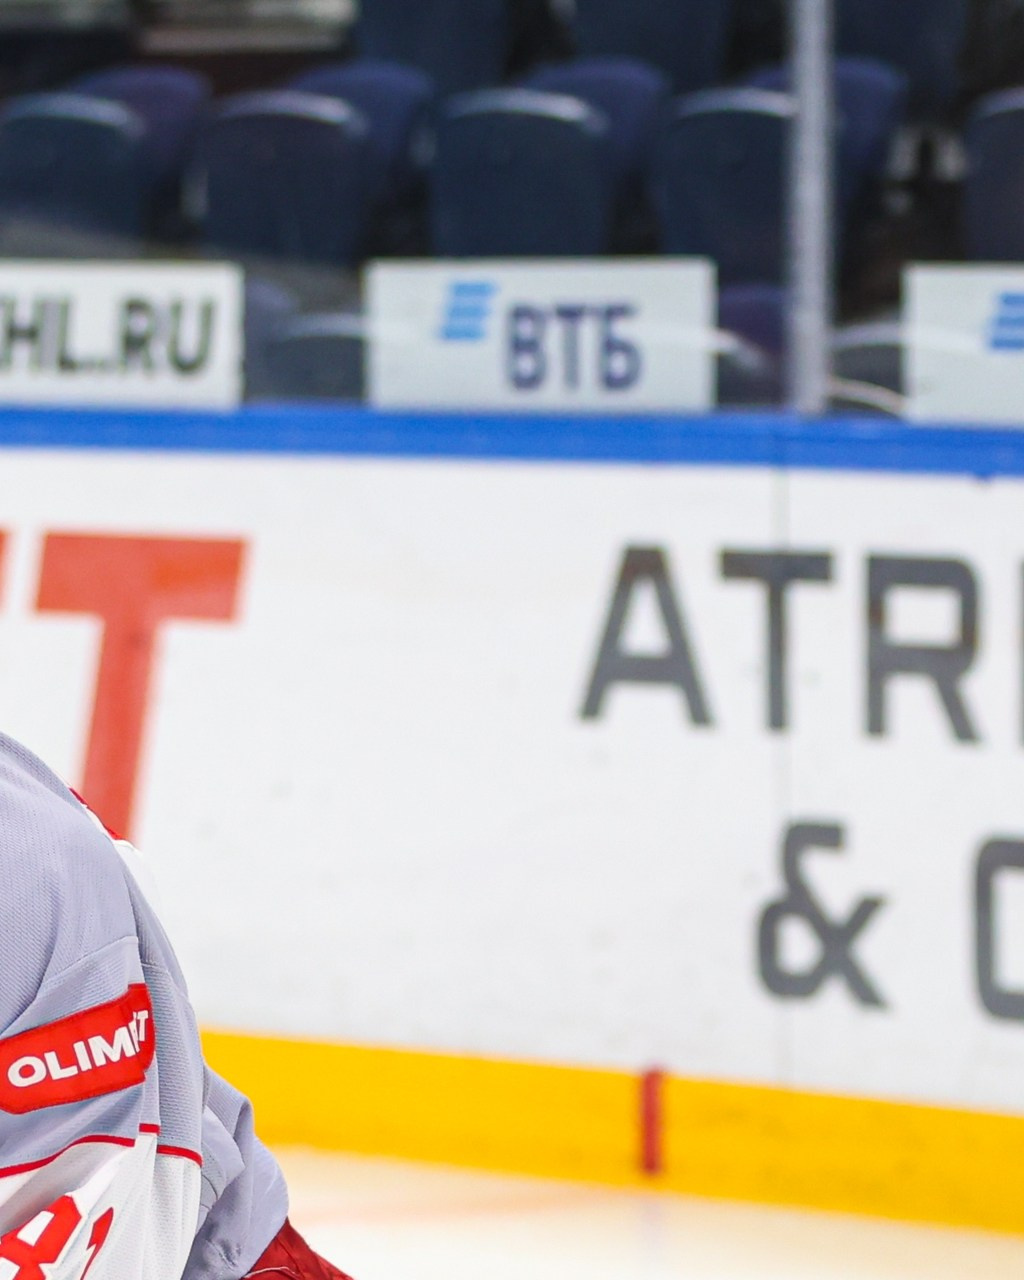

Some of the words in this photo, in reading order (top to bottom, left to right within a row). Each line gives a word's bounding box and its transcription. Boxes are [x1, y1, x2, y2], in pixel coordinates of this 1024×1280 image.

[506, 303, 641, 391] ВТБ
[578, 544, 1024, 744] ATR
[757, 820, 889, 1012] &
